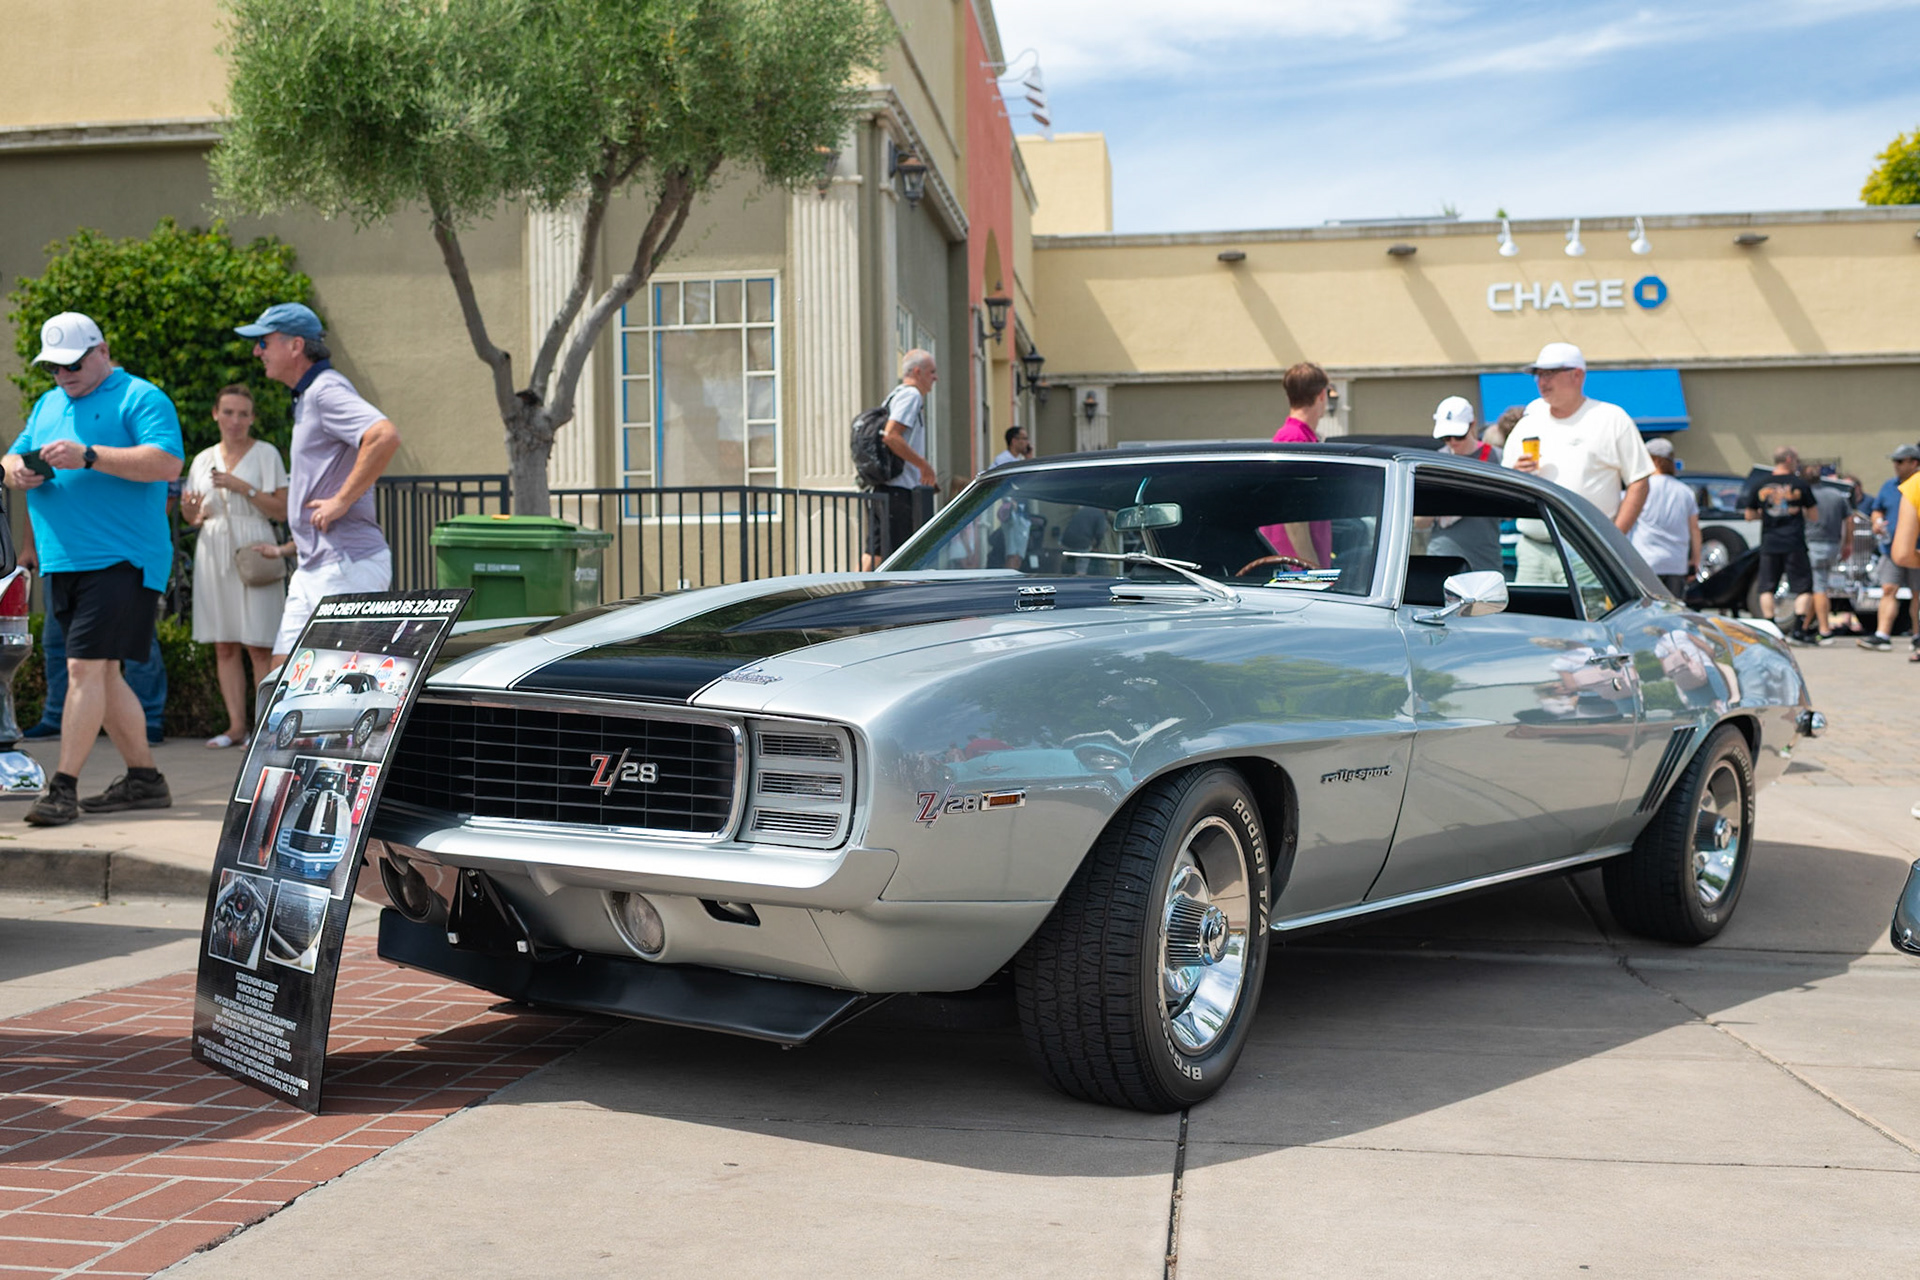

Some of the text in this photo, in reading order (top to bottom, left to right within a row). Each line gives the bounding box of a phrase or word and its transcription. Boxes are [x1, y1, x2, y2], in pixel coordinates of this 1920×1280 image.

[1486, 278, 1625, 311] CHASE
[1016, 585, 1057, 595] 302
[316, 598, 460, 616] 1969 CHEVY CAMARO RS Z/28 X33
[590, 747, 659, 796] Z/28
[914, 783, 979, 828] Z/28
[1232, 799, 1265, 874] Radial
[1259, 885, 1268, 936] T/A
[290, 1074, 309, 1091] BUMPER
